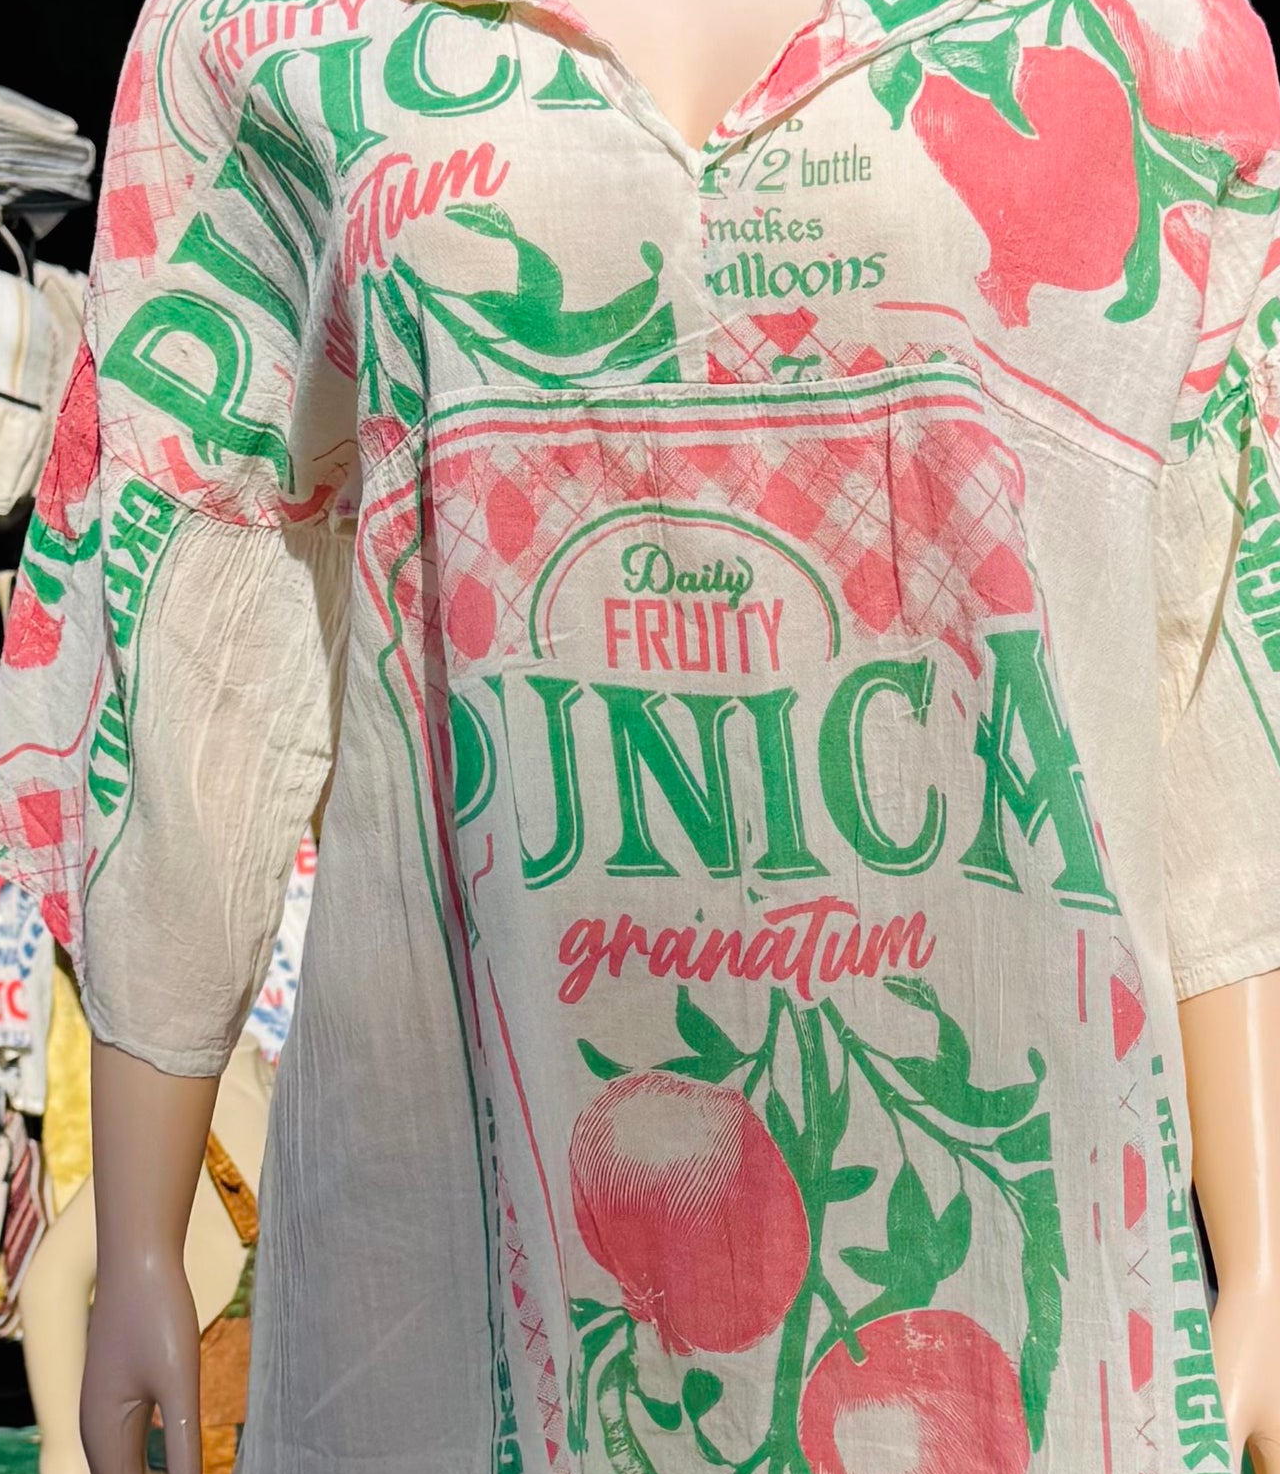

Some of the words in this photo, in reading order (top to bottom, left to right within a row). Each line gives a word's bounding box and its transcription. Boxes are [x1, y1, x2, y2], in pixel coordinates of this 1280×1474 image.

[801, 142, 872, 188] bottle
[706, 207, 825, 244] makes
[621, 541, 754, 610] Daily
[557, 895, 939, 1003] granatum
